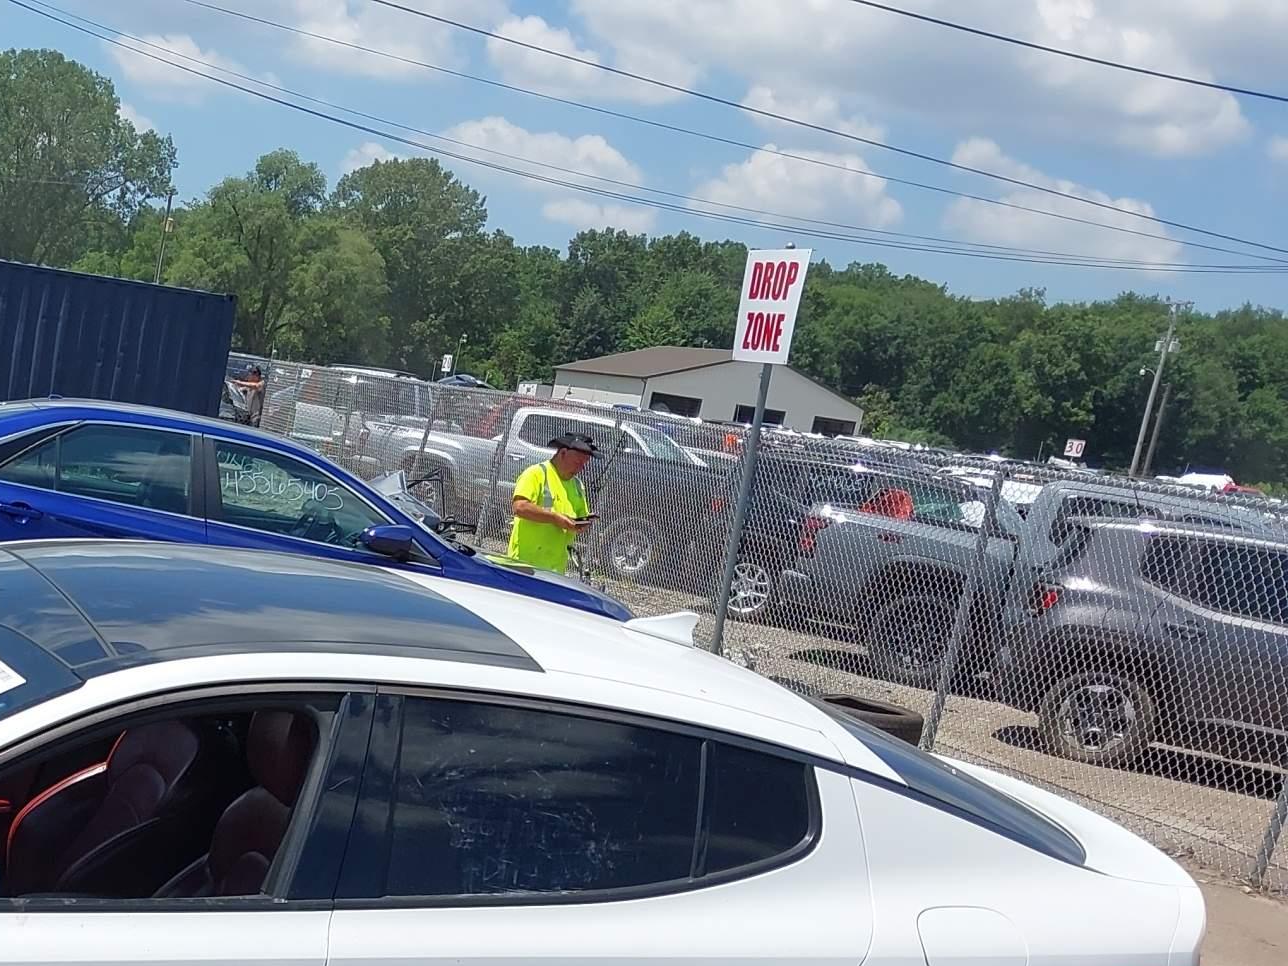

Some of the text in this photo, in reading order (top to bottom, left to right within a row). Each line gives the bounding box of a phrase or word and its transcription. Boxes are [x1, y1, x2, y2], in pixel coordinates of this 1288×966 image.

[748, 261, 800, 301] DROP
[741, 311, 786, 353] ZONE
[1065, 441, 1084, 455] 30
[223, 470, 345, 511] 45565405
